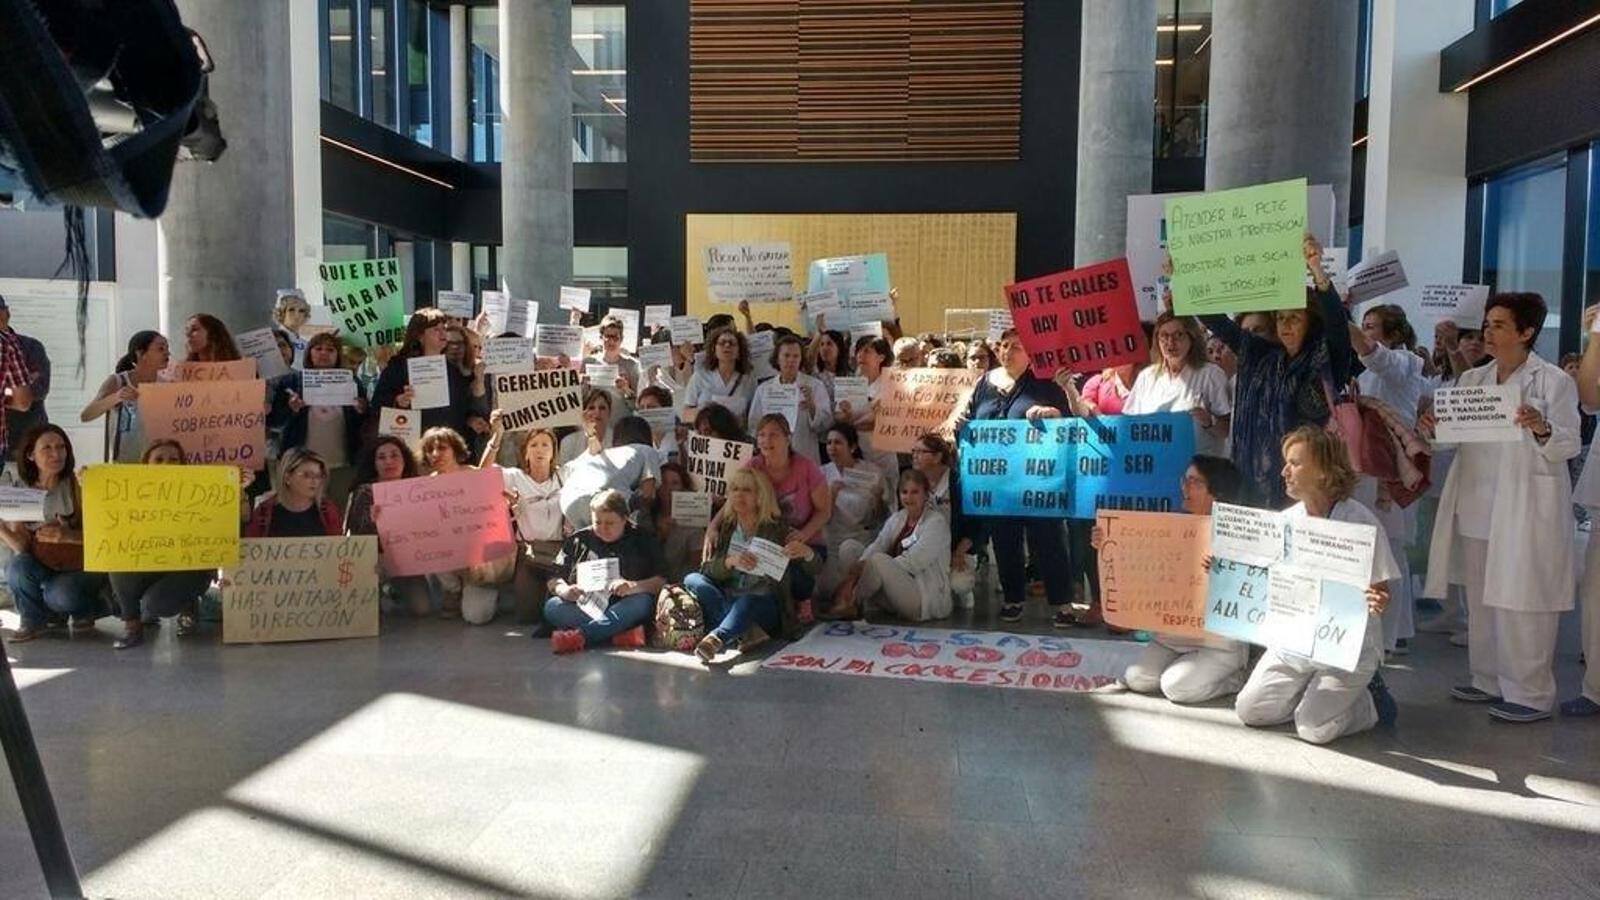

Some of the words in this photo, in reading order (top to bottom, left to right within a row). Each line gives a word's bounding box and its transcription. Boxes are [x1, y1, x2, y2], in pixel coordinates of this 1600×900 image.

[1171, 205, 1225, 232] ATENDER
[1232, 206, 1248, 219] AL
[1255, 199, 1288, 215] PCTE
[1171, 237, 1185, 250] ES
[1188, 229, 1232, 248] NUESTRA
[319, 260, 398, 281] QUIEREN
[1010, 290, 1030, 309] NO
[1036, 285, 1055, 304] TE
[1060, 271, 1119, 300] CALLES
[344, 306, 379, 333] CON
[1031, 314, 1058, 335] HAY
[1073, 306, 1108, 329] QUE
[364, 325, 406, 347] TODO
[498, 370, 580, 393] GERENCIA
[174, 394, 194, 408] NO
[501, 391, 580, 431] DIMISIÓN
[1452, 405, 1496, 413] TRASLADO
[172, 412, 265, 434] SOBRECARGA
[1056, 424, 1088, 444] SER
[1130, 422, 1172, 443] GRAN
[184, 443, 254, 465] RABAJO
[690, 436, 710, 455] QUE
[723, 441, 742, 461] SE
[688, 457, 725, 478] VAYAN
[968, 457, 1008, 476] LIDER
[1025, 458, 1056, 476] HAY
[1079, 456, 1108, 476] QUE
[1125, 454, 1154, 474] SER
[102, 478, 236, 509] DIGNIDAD
[972, 490, 993, 508] UN
[1022, 489, 1069, 509] GRAN
[233, 568, 319, 587] CUANTA
[1238, 581, 1254, 599] EL
[249, 602, 356, 630] DIRECCIÓN
[824, 622, 1073, 651] BOLSAS
